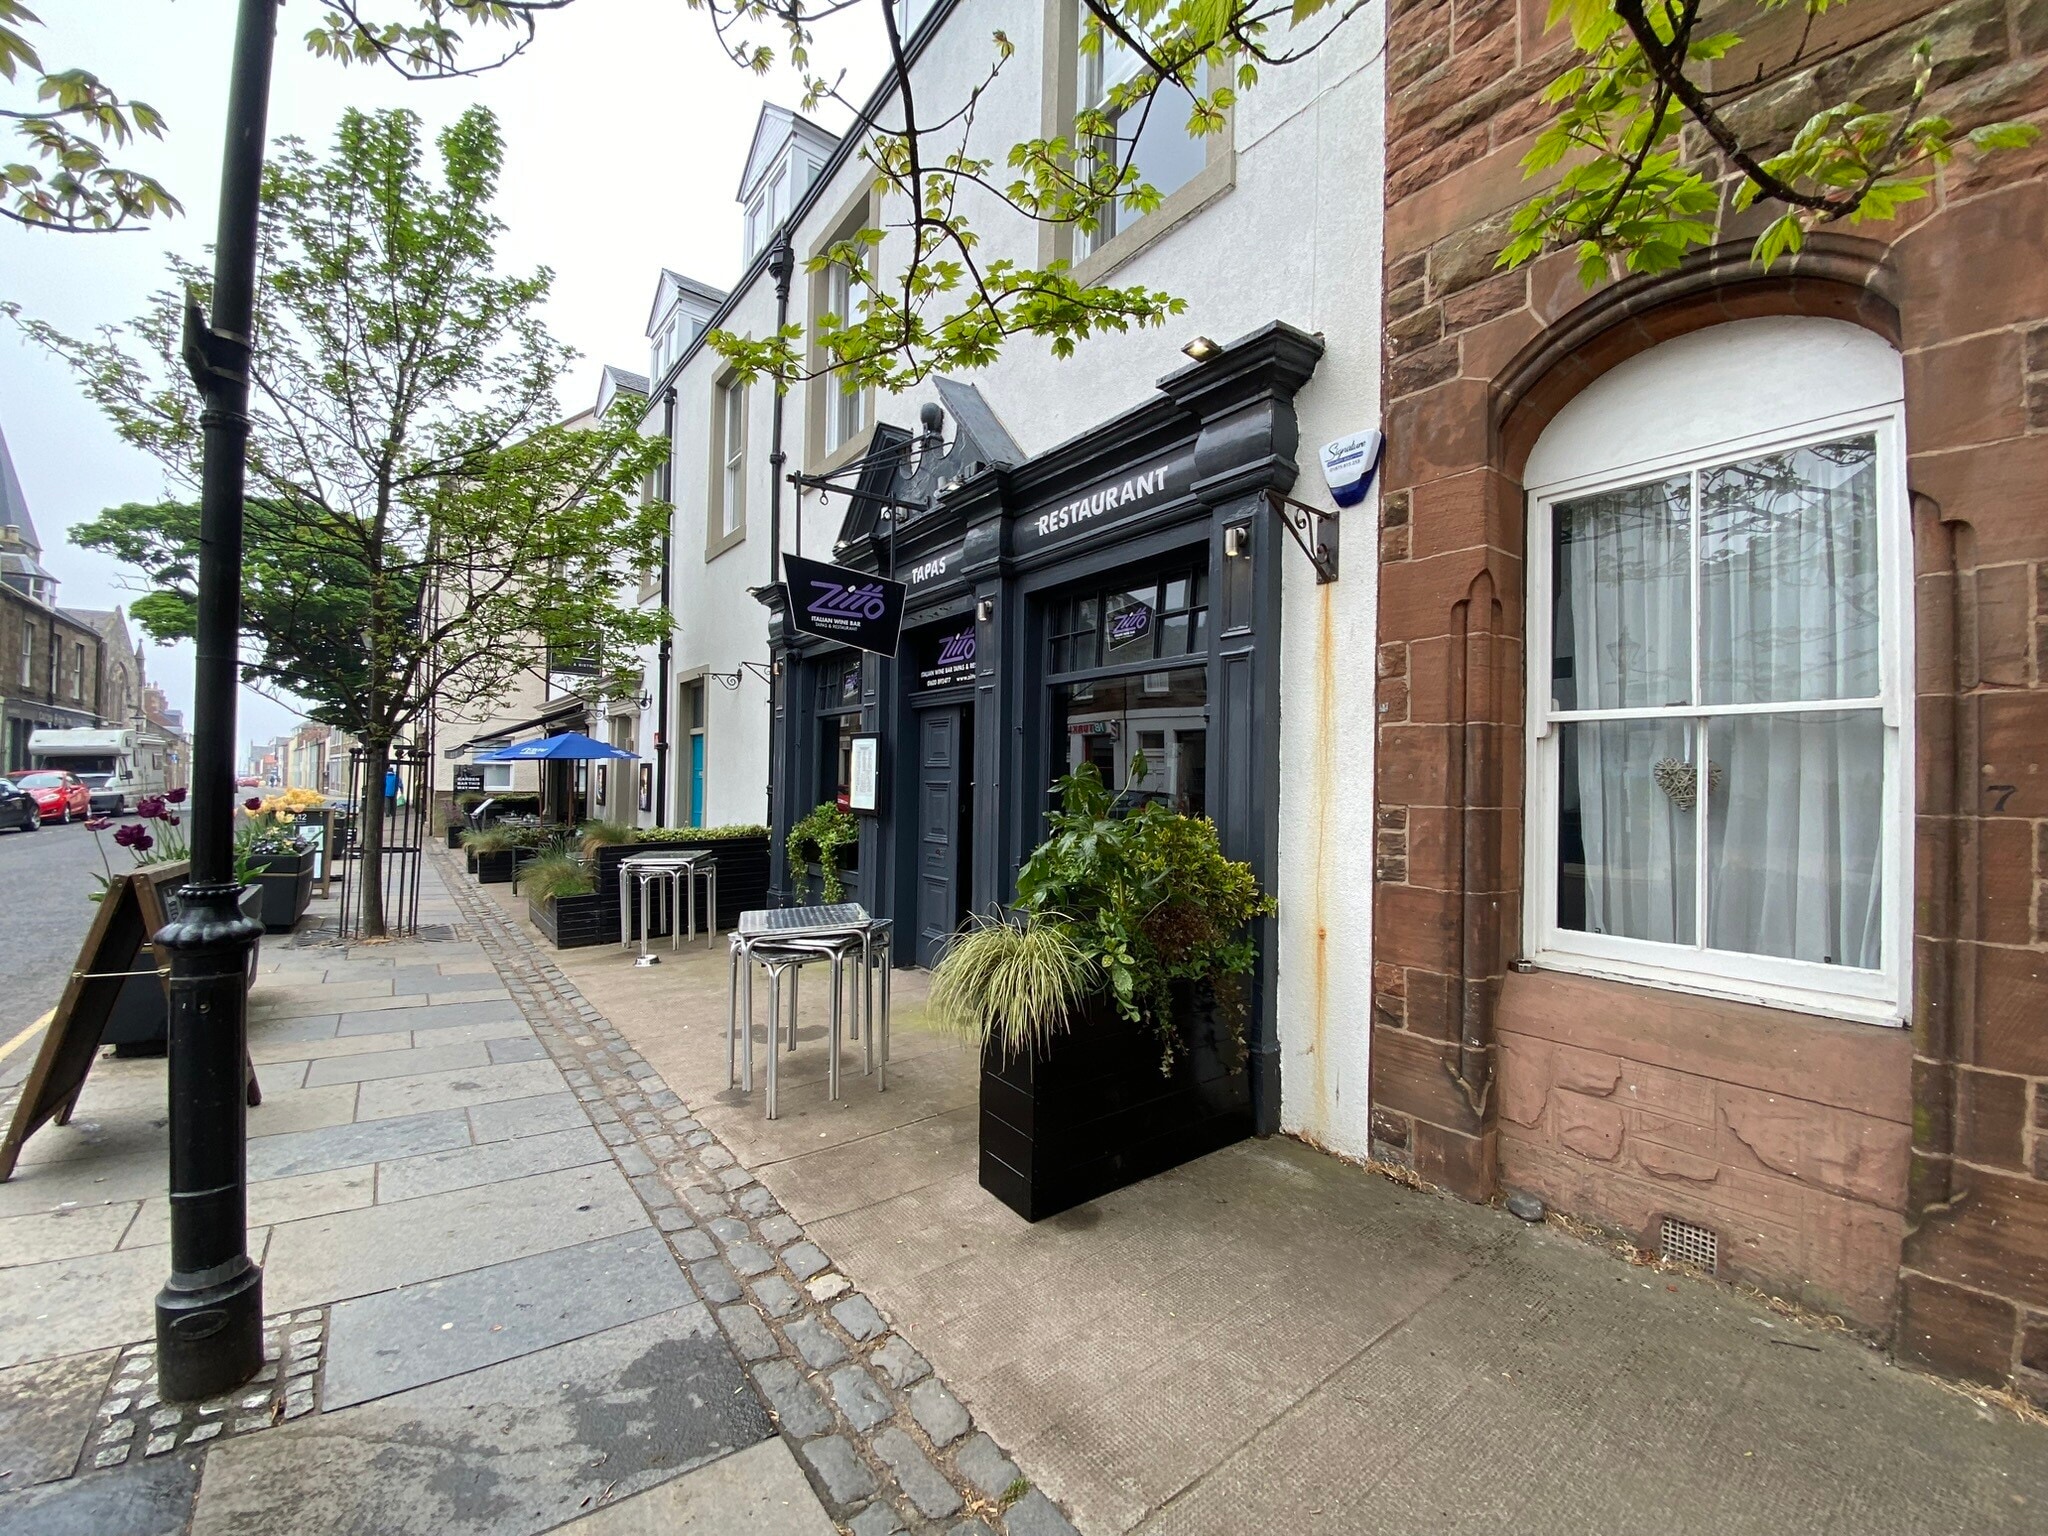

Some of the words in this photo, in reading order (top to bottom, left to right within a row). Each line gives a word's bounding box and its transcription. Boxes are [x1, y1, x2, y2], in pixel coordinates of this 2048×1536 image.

[1037, 465, 1169, 537] RESTAURANT
[911, 556, 947, 585] TAPAS
[811, 615, 833, 624] ITALIAN
[833, 618, 849, 626] WINE
[1986, 785, 2017, 812] 7
